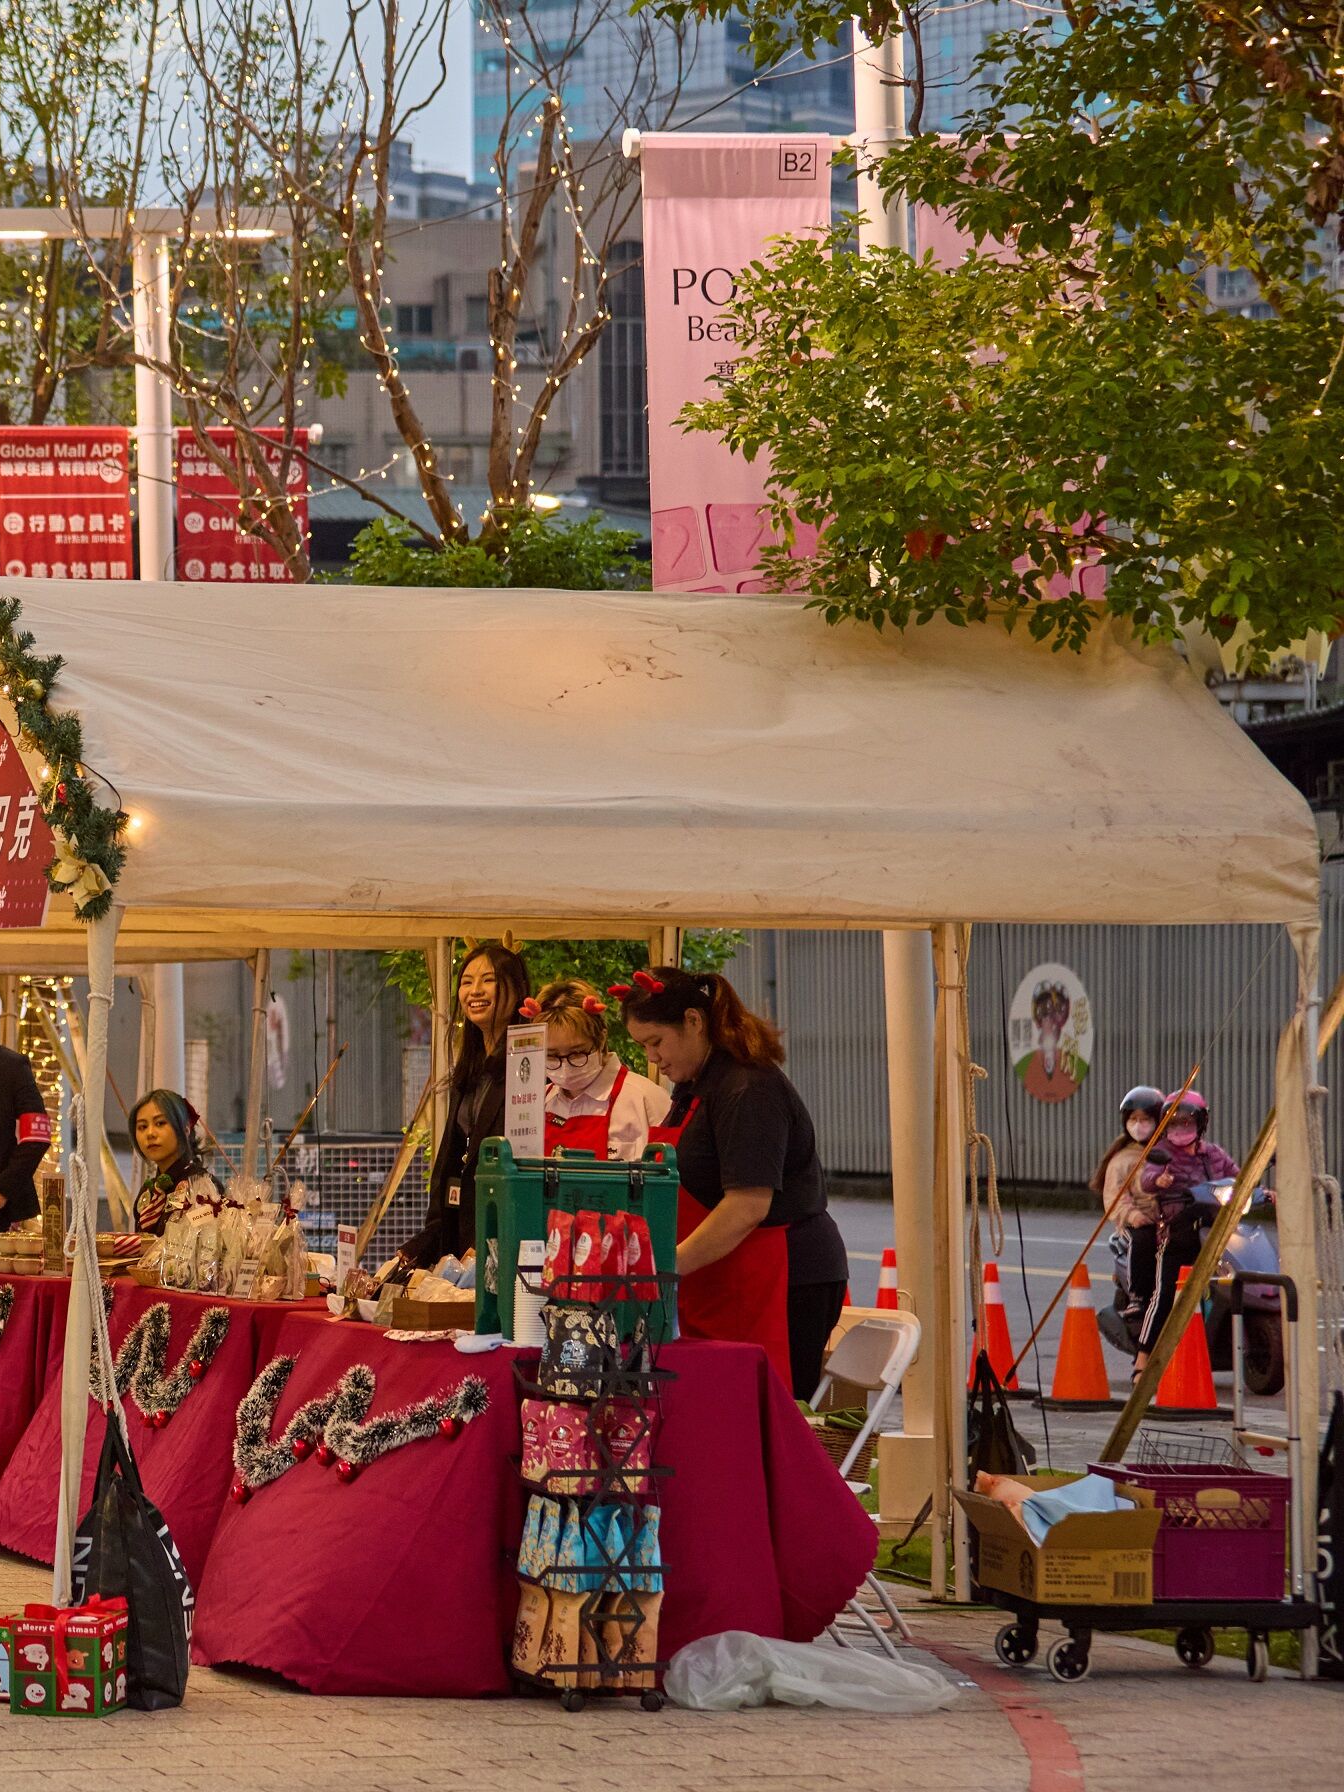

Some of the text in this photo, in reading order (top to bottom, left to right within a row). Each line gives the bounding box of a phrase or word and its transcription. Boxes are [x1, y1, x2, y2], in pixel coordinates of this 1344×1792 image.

[783, 152, 812, 173] B2
[0, 442, 124, 458] Global Mall APP
[28, 512, 126, 533] 行動會員卡
[22, 1623, 48, 1633] Merry
